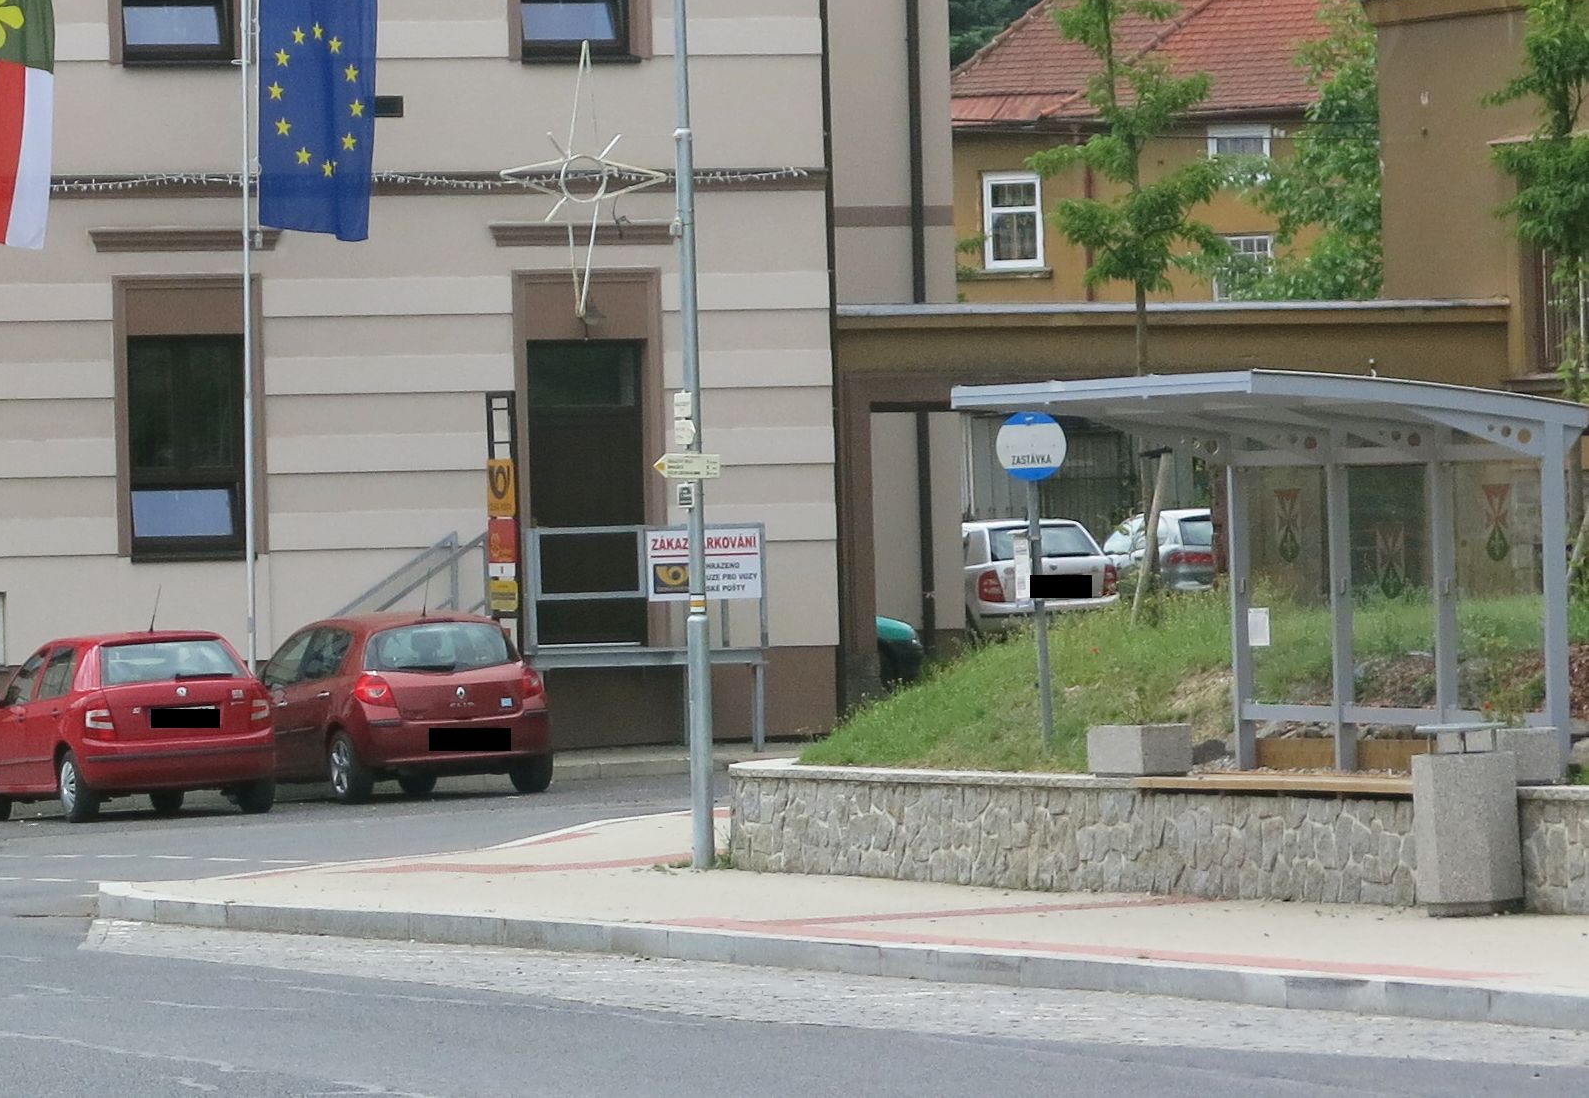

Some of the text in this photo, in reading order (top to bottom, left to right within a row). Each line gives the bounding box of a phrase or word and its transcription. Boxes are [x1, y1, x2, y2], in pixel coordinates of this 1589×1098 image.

[1011, 454, 1051, 465] ZASTÁVKA
[651, 533, 757, 551] ZÁKAZ RKOVÁNÍ
